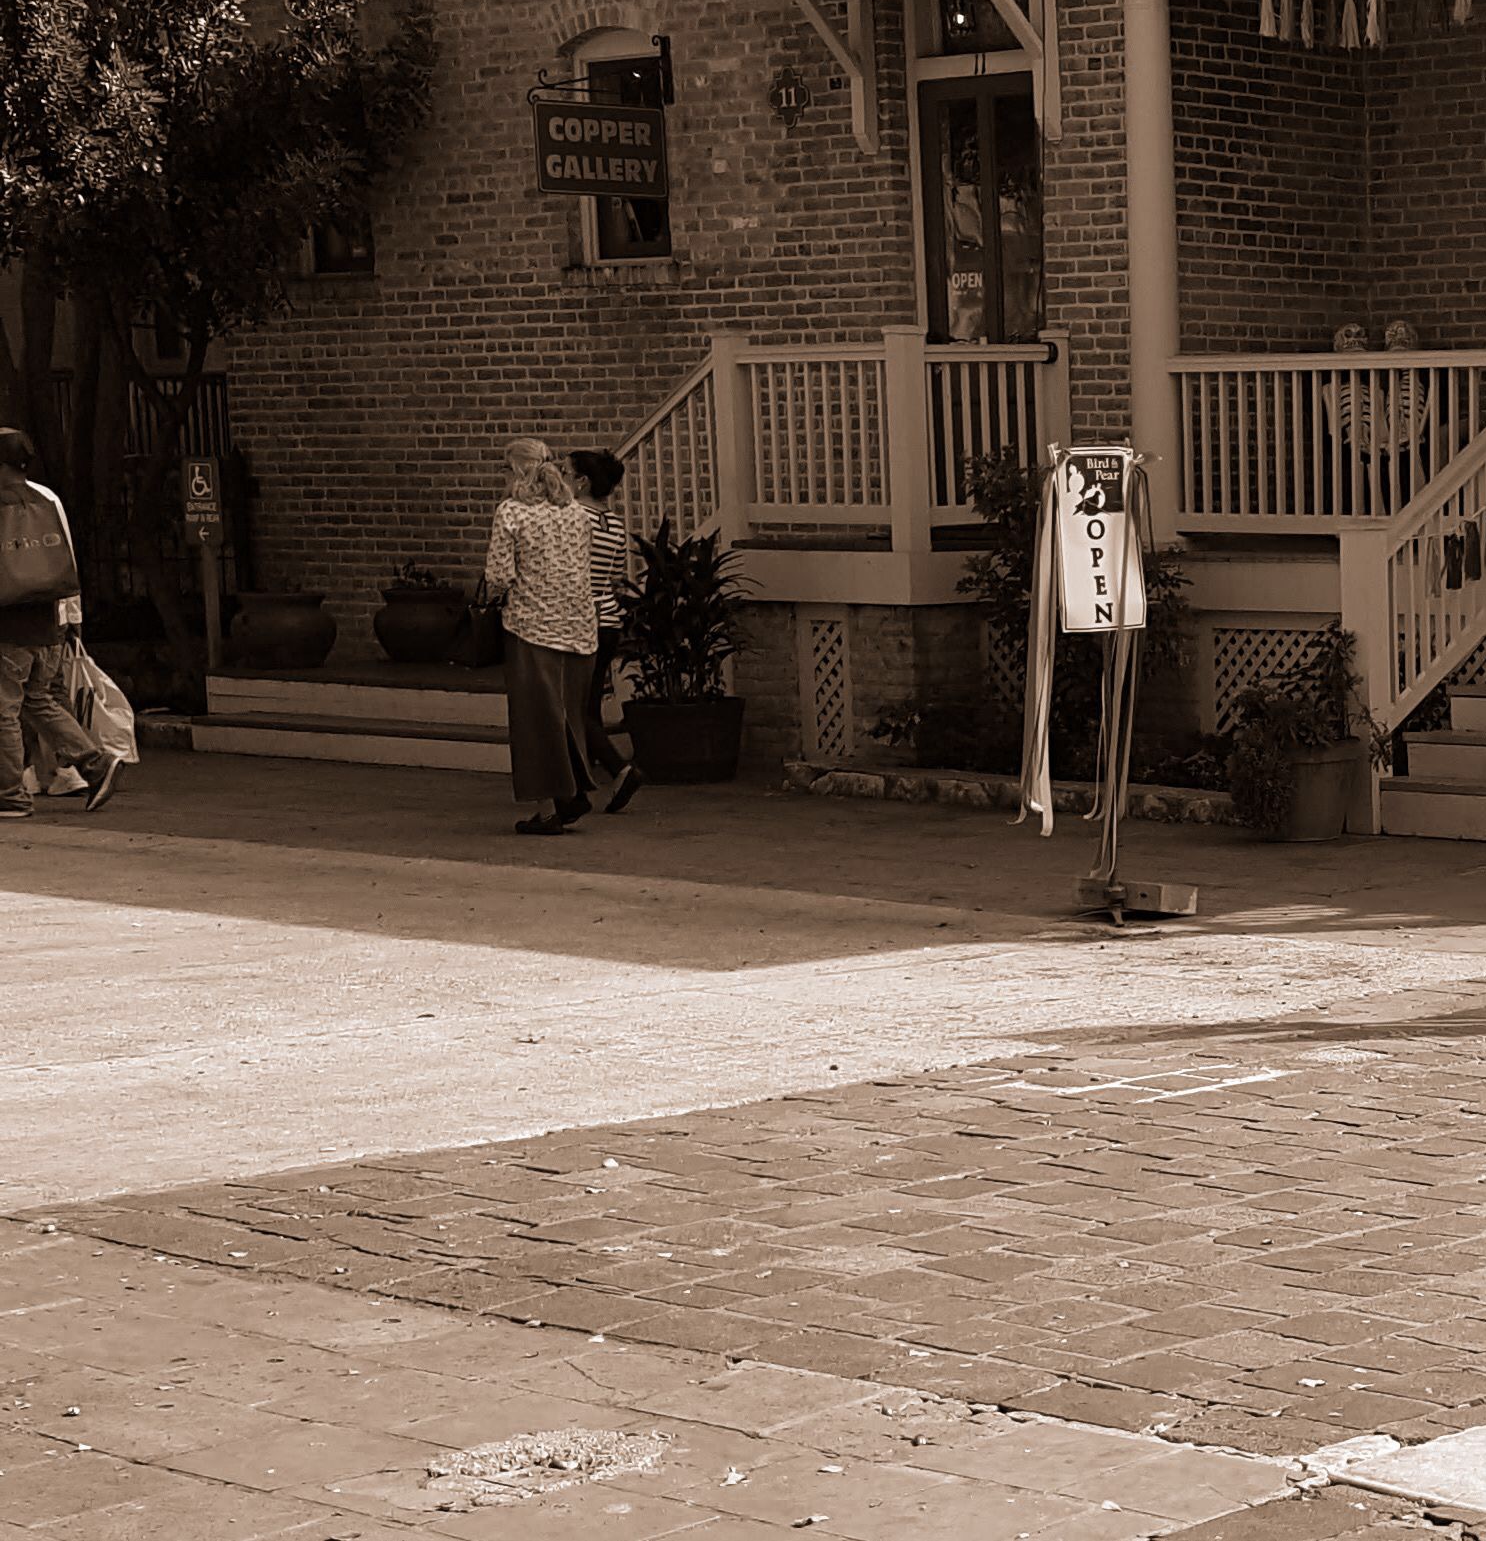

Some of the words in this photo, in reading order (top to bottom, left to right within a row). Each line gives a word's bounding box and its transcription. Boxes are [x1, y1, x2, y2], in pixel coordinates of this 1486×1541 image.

[779, 87, 797, 108] 11
[548, 116, 652, 147] COPPER
[545, 154, 657, 184] GALLERY
[952, 272, 983, 289] OPEN
[1086, 457, 1110, 469] Bird
[1095, 469, 1120, 481] Pear
[1086, 518, 1114, 624] OPEN
